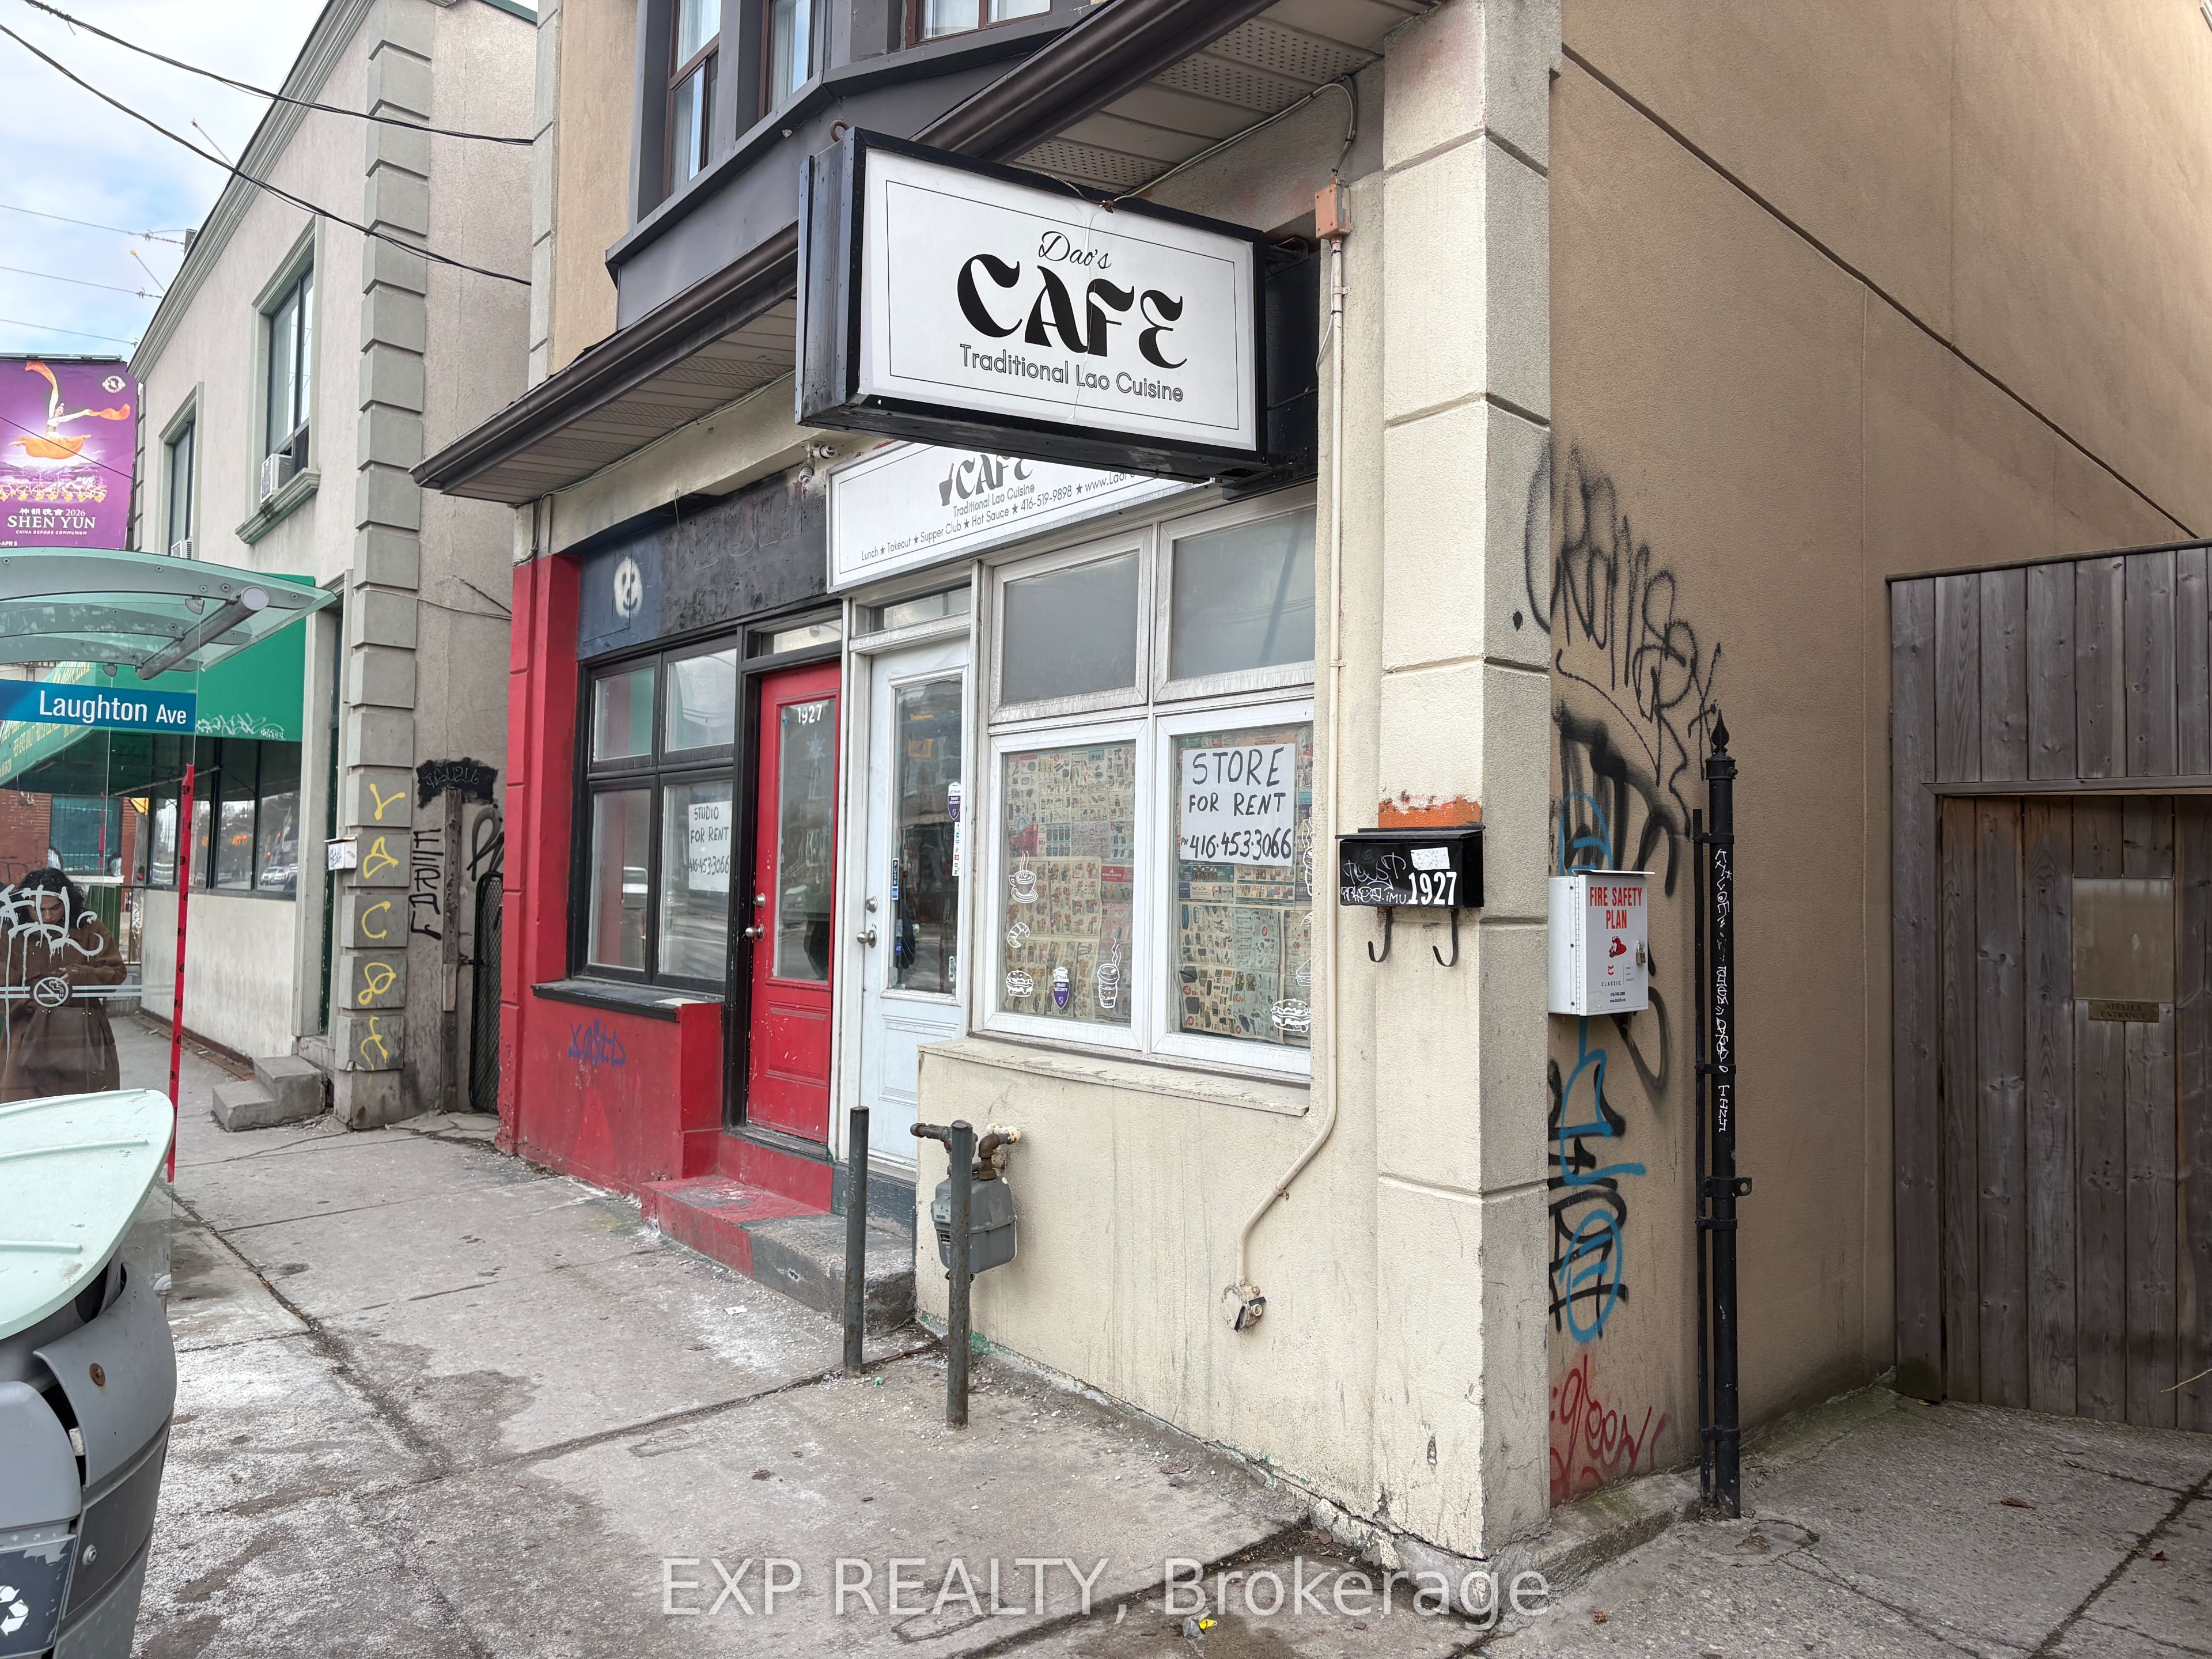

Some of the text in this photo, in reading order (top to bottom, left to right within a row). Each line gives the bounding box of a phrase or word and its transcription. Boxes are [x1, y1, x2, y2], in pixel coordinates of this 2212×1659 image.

[1038, 230, 1112, 270] Dao's
[957, 253, 1188, 369] CAFE
[960, 343, 1184, 403] Traditional Lao Cuisine
[66, 509, 86, 517] 2026
[953, 484, 1035, 518] Traditional Lao Cuisine
[7, 515, 96, 529] SHEN YUN
[861, 547, 878, 561] Lunch
[887, 537, 911, 554] Takeout
[920, 529, 944, 544] Supper
[945, 520, 962, 535] Club
[972, 514, 984, 528] Hot
[986, 506, 1009, 523] Sauce
[1020, 484, 1073, 512] 416-519-9898
[40, 690, 147, 724] Laughton
[156, 704, 187, 725] Ave
[797, 703, 823, 726] 1927
[1192, 747, 1285, 787] STORE
[1188, 792, 1286, 816] FOR RENT
[691, 826, 729, 843] FOR RENT
[1408, 872, 1457, 906] 1927
[1589, 887, 1642, 907] FIRE SAFETY
[1605, 910, 1627, 929] PLAN
[2101, 1011, 2146, 1019] ENTRANCE
